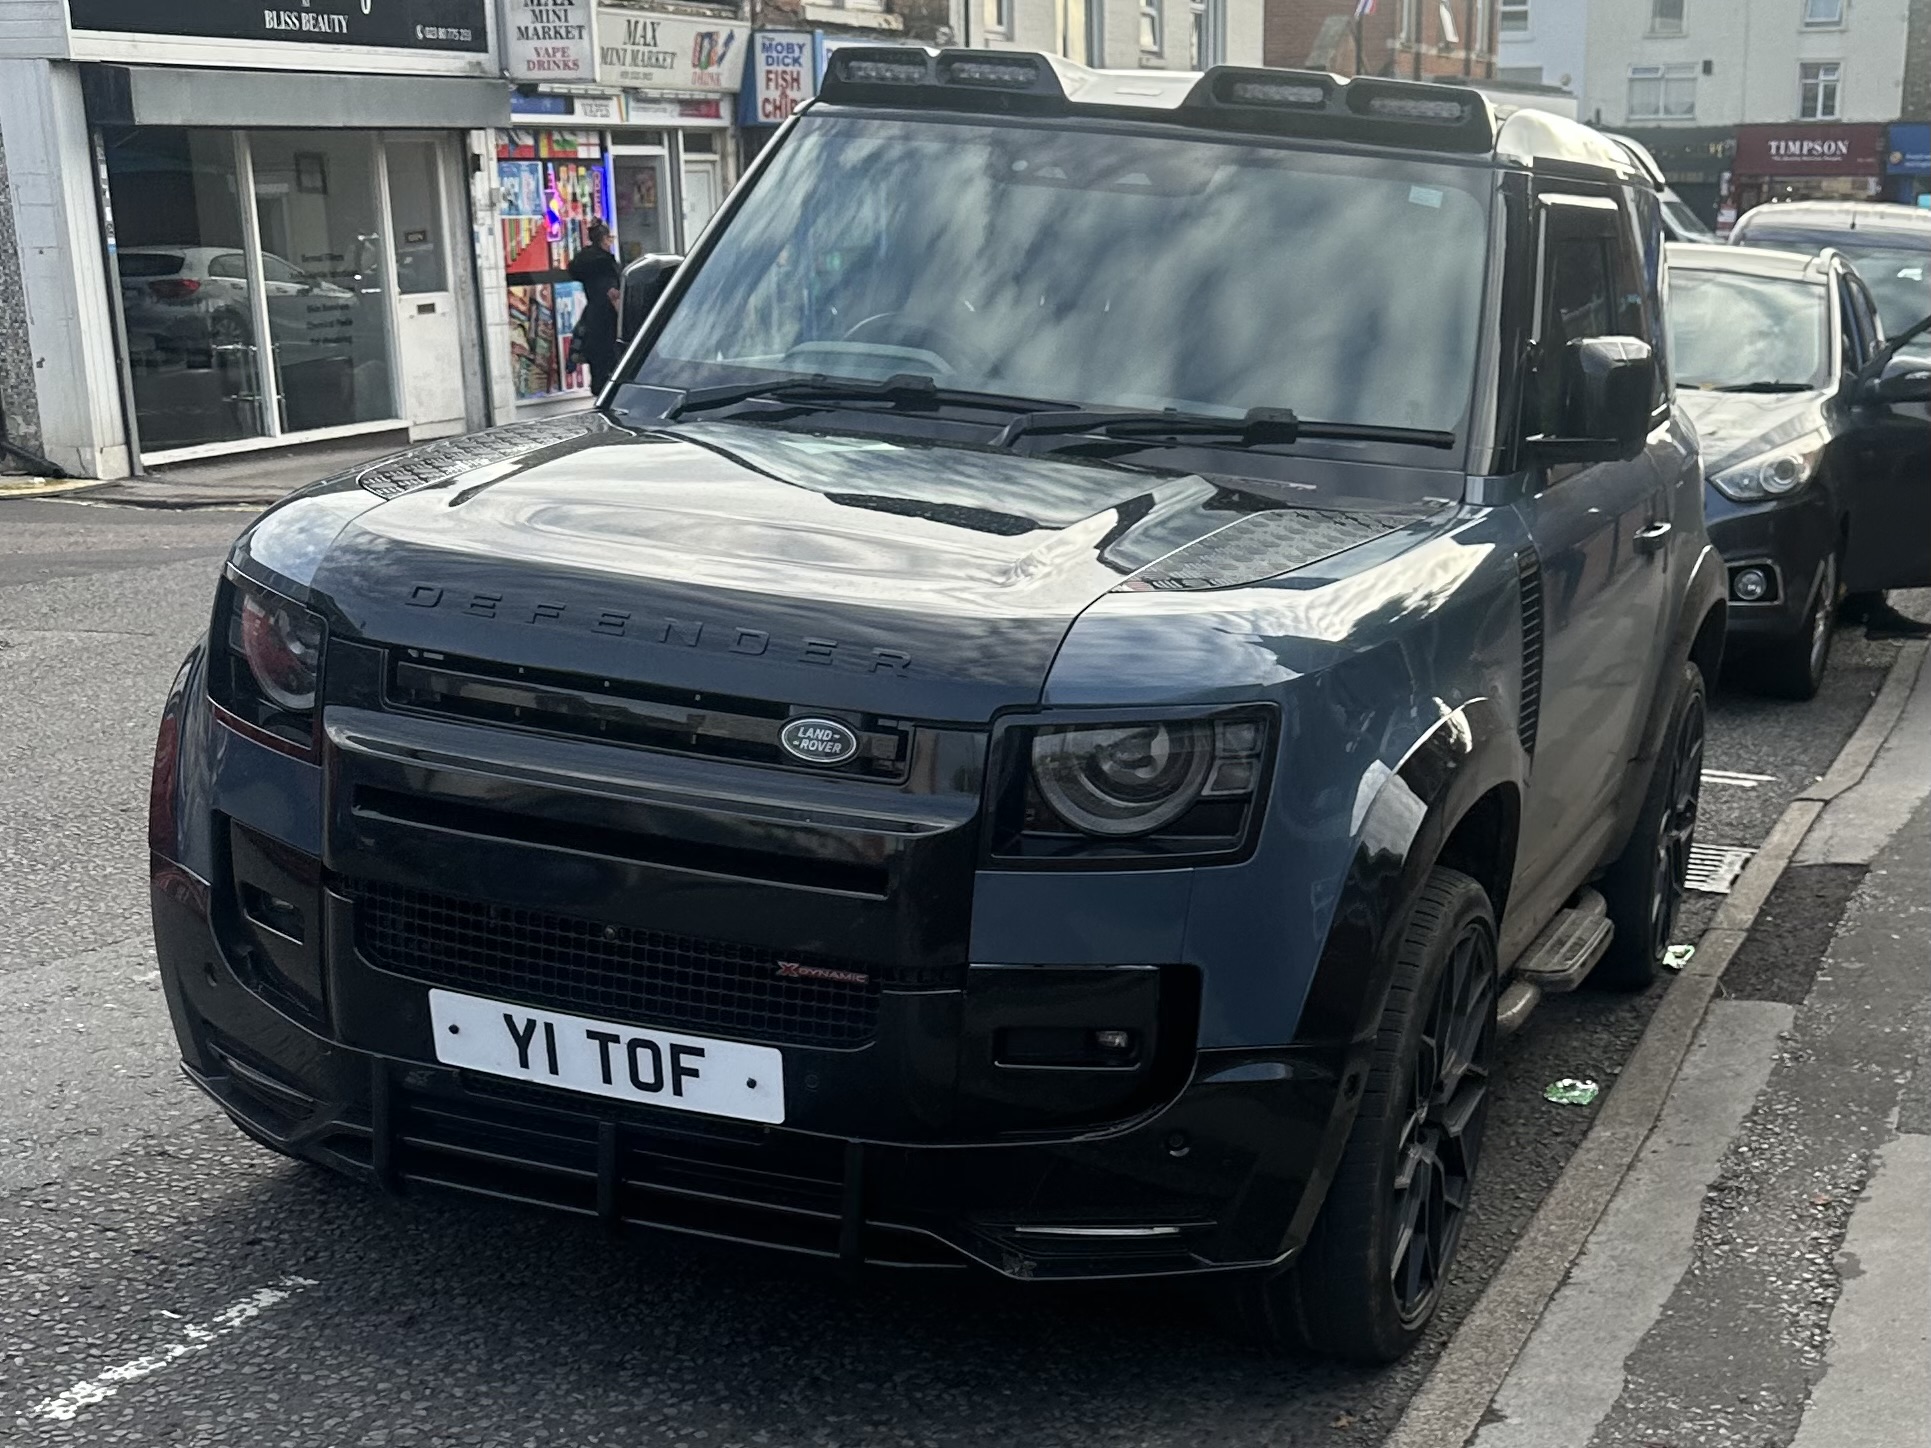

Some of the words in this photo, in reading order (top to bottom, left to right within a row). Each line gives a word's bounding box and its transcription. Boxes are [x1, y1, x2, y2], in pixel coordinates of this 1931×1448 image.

[264, 10, 300, 30] BLISS
[301, 12, 348, 33] BEAUTY
[531, 9, 570, 24] MINI
[517, 25, 585, 41] MARKET
[623, 19, 661, 47] MAX
[534, 46, 571, 59] VAPE
[762, 42, 806, 55] MOBY
[527, 59, 580, 72] DRINKS
[600, 46, 628, 67] MINI
[629, 48, 677, 70] MARKET
[766, 55, 803, 68] DICK
[765, 70, 801, 92] FISH
[762, 98, 799, 119] CHIP
[1768, 140, 1850, 155] TIMPSON
[404, 581, 913, 678] DEFENDER
[585, 1029, 706, 1098] TOF
